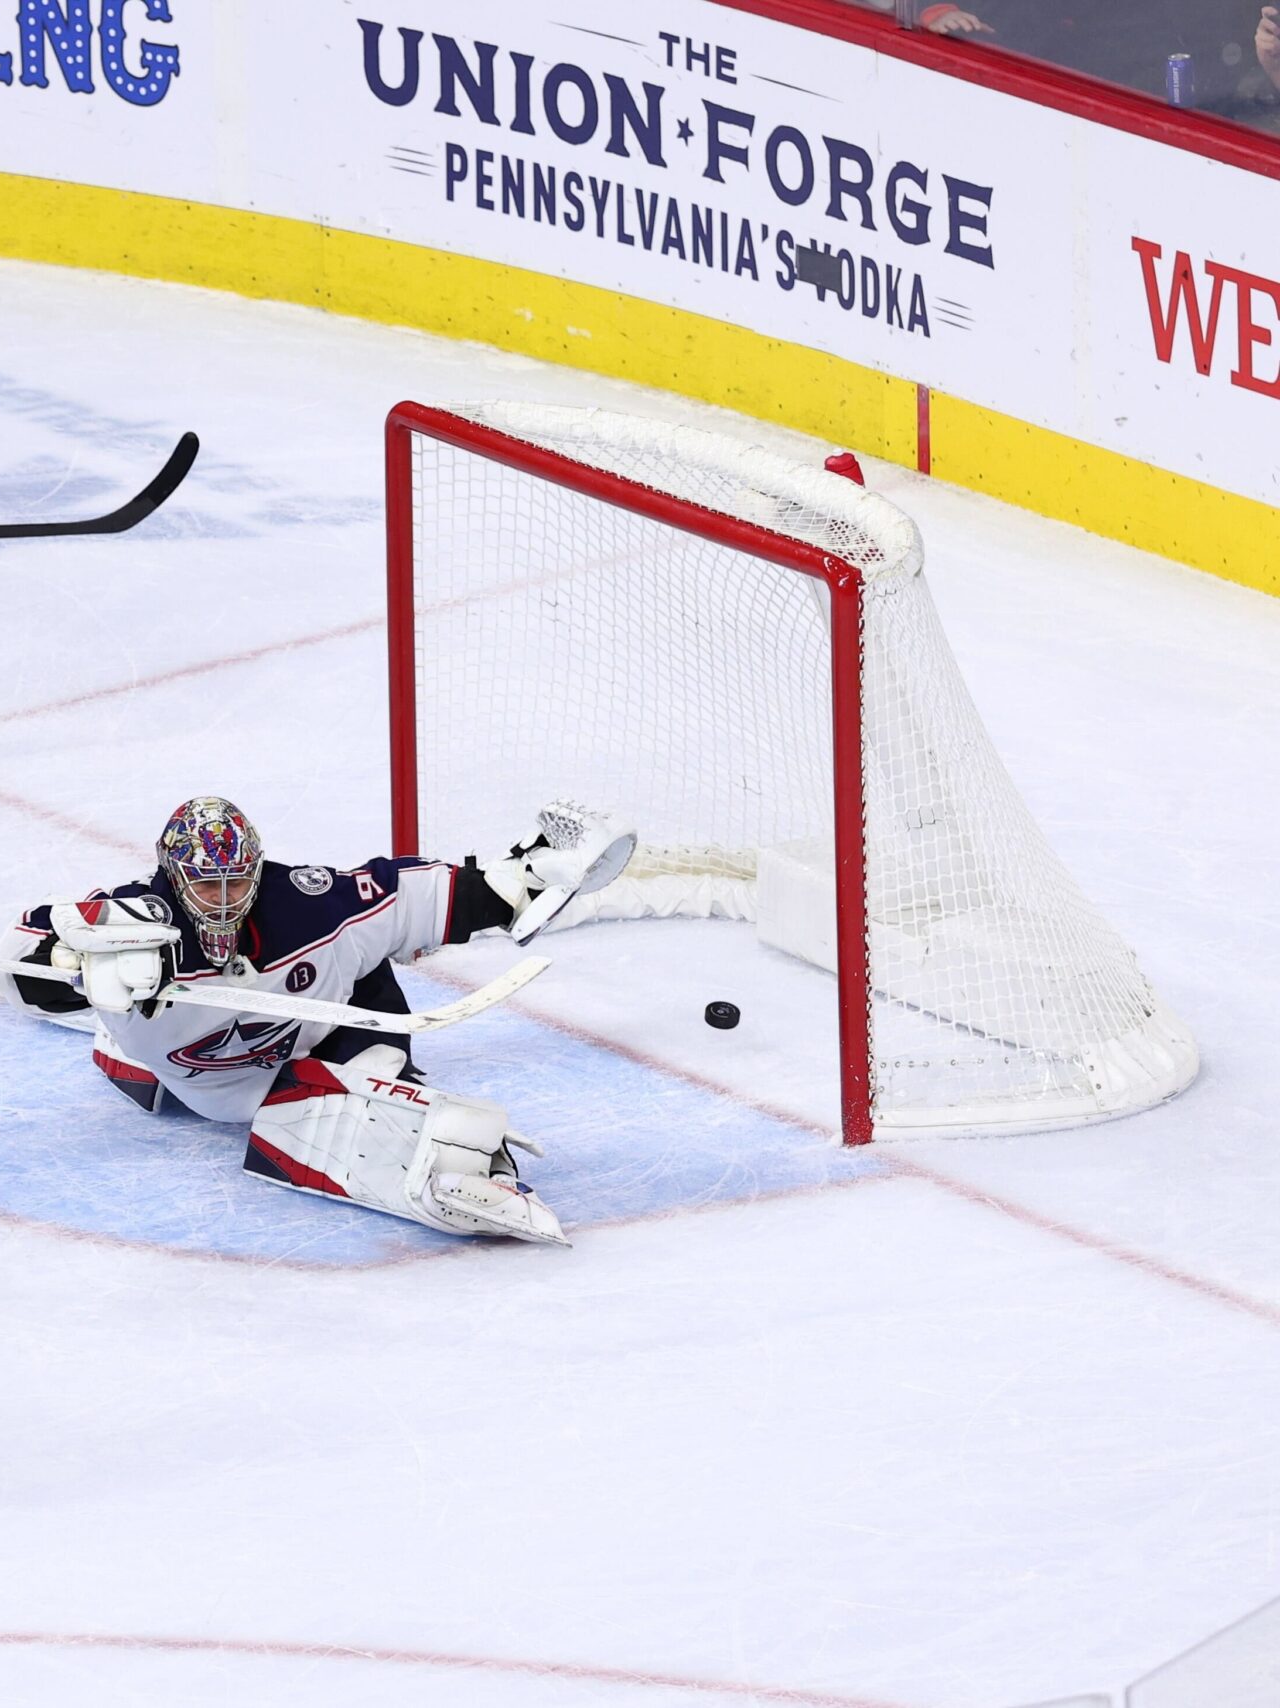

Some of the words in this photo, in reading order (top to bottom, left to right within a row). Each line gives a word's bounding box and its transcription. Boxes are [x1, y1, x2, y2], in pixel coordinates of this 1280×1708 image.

[659, 31, 737, 85] THE
[357, 18, 668, 168] UNION
[701, 97, 995, 270] FORGE
[445, 142, 796, 291] PENNSYLVANIA'S
[1131, 235, 1280, 401] WE
[293, 966, 310, 989] 13
